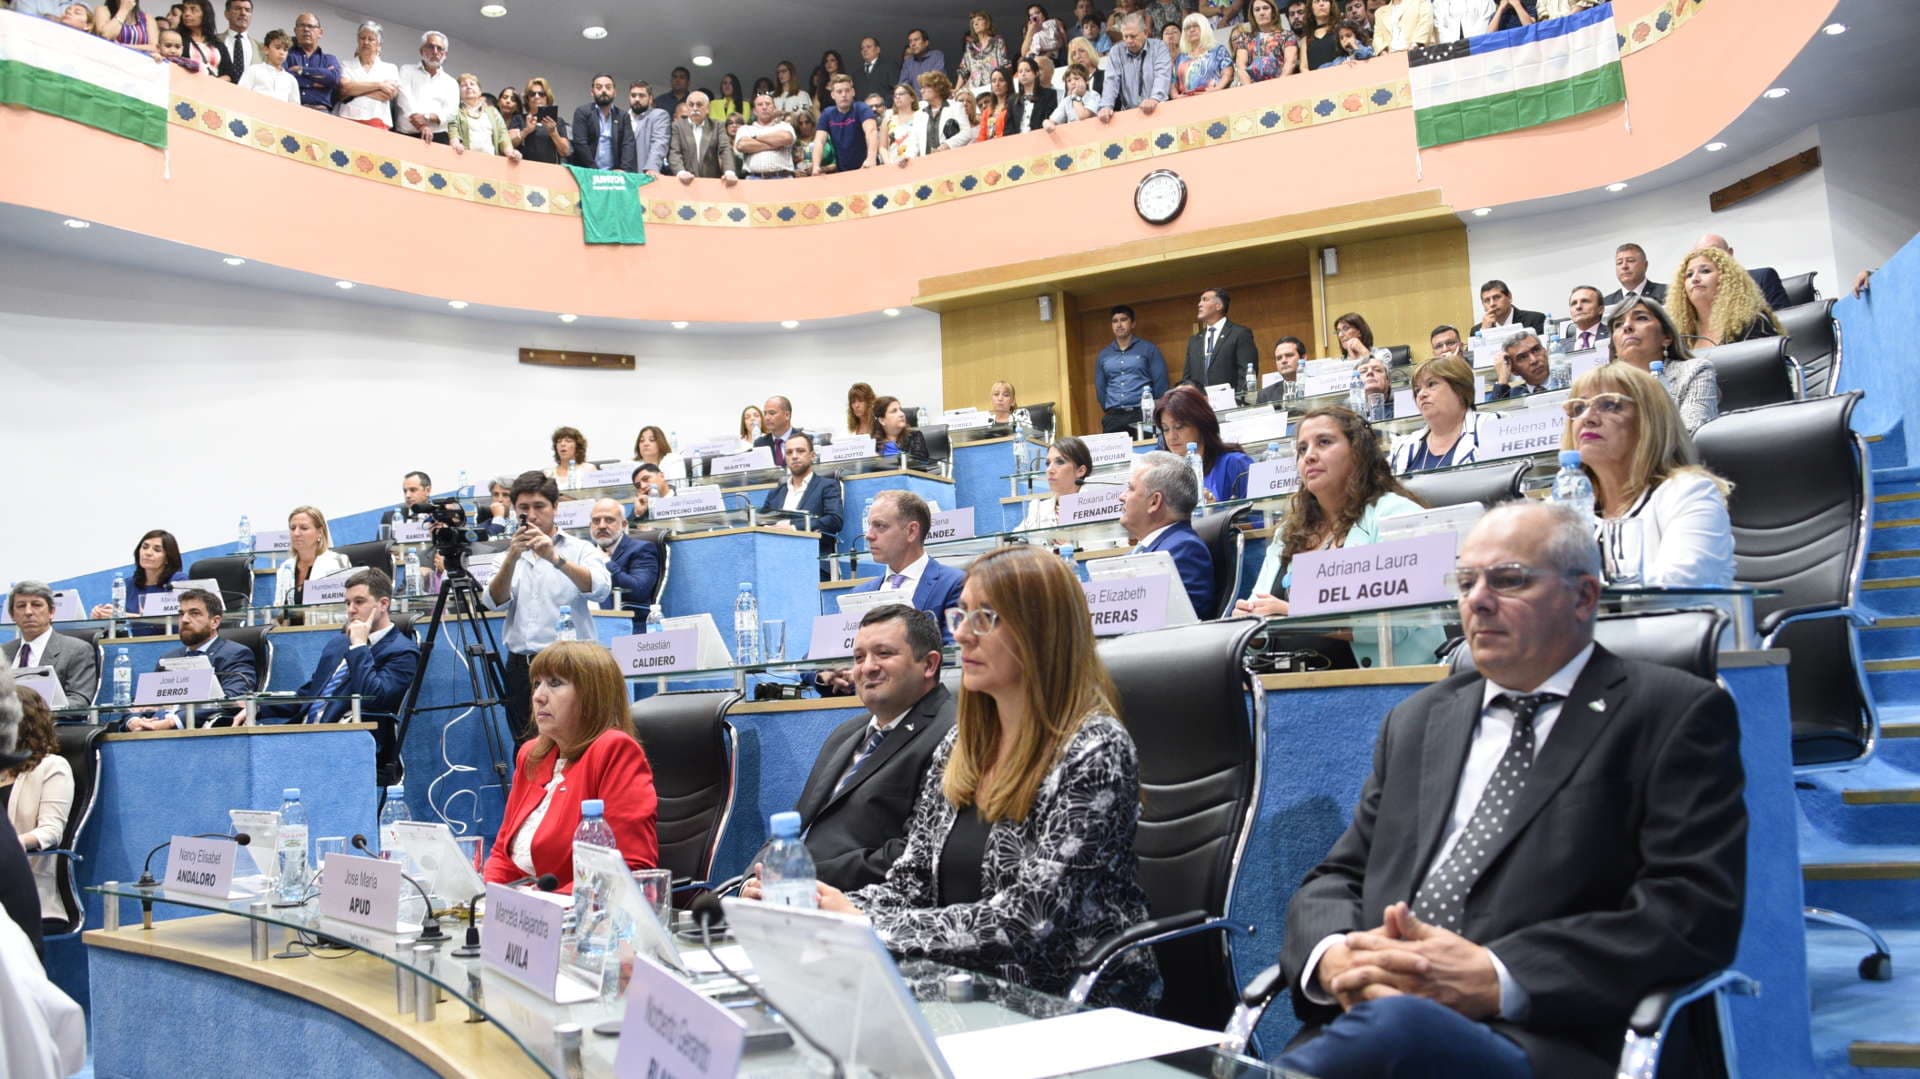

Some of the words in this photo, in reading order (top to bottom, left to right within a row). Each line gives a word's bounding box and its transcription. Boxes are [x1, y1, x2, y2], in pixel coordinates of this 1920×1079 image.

[1502, 434, 1559, 452] HERRE
[1270, 476, 1302, 489] GEMIG
[926, 528, 956, 540] ANDEZ
[1316, 559, 1370, 578] Adriana
[1376, 552, 1418, 571] Laura
[321, 592, 345, 600] MARIN
[1099, 586, 1147, 603] Elizabeth
[1318, 586, 1351, 604] DEL
[1356, 578, 1409, 600] AGUA
[632, 655, 676, 669] CALDIERO
[156, 687, 189, 697] BERROS
[178, 848, 197, 866] Nancy
[176, 869, 216, 888] ANDALORO
[349, 897, 371, 916] APUD
[504, 941, 529, 971] AVILA
